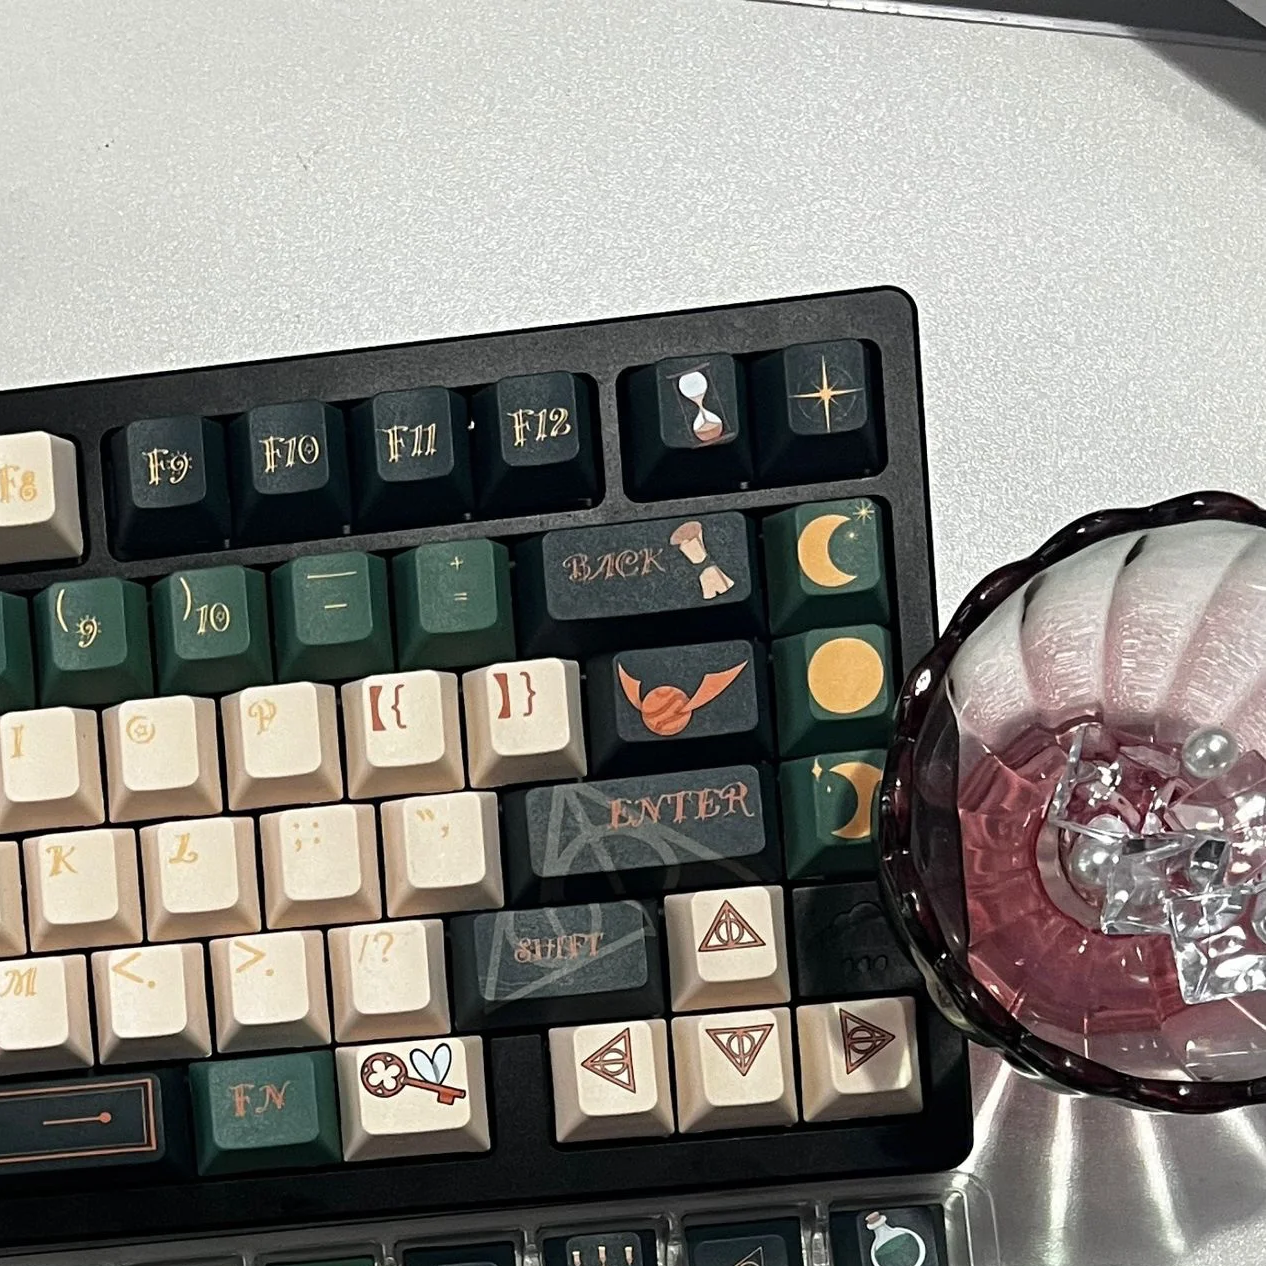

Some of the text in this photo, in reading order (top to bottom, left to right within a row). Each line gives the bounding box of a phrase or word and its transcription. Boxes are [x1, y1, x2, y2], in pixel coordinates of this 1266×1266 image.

[376, 423, 439, 463] F11
[507, 407, 573, 447] F12
[142, 448, 193, 485] F9
[259, 434, 322, 474] F10
[563, 548, 665, 582] BACK
[75, 614, 102, 649] 9
[248, 699, 277, 735] P
[10, 725, 26, 759] I
[607, 781, 756, 830] ENTER
[45, 844, 78, 876] K
[168, 832, 199, 866] L
[229, 1080, 291, 1118] FN
